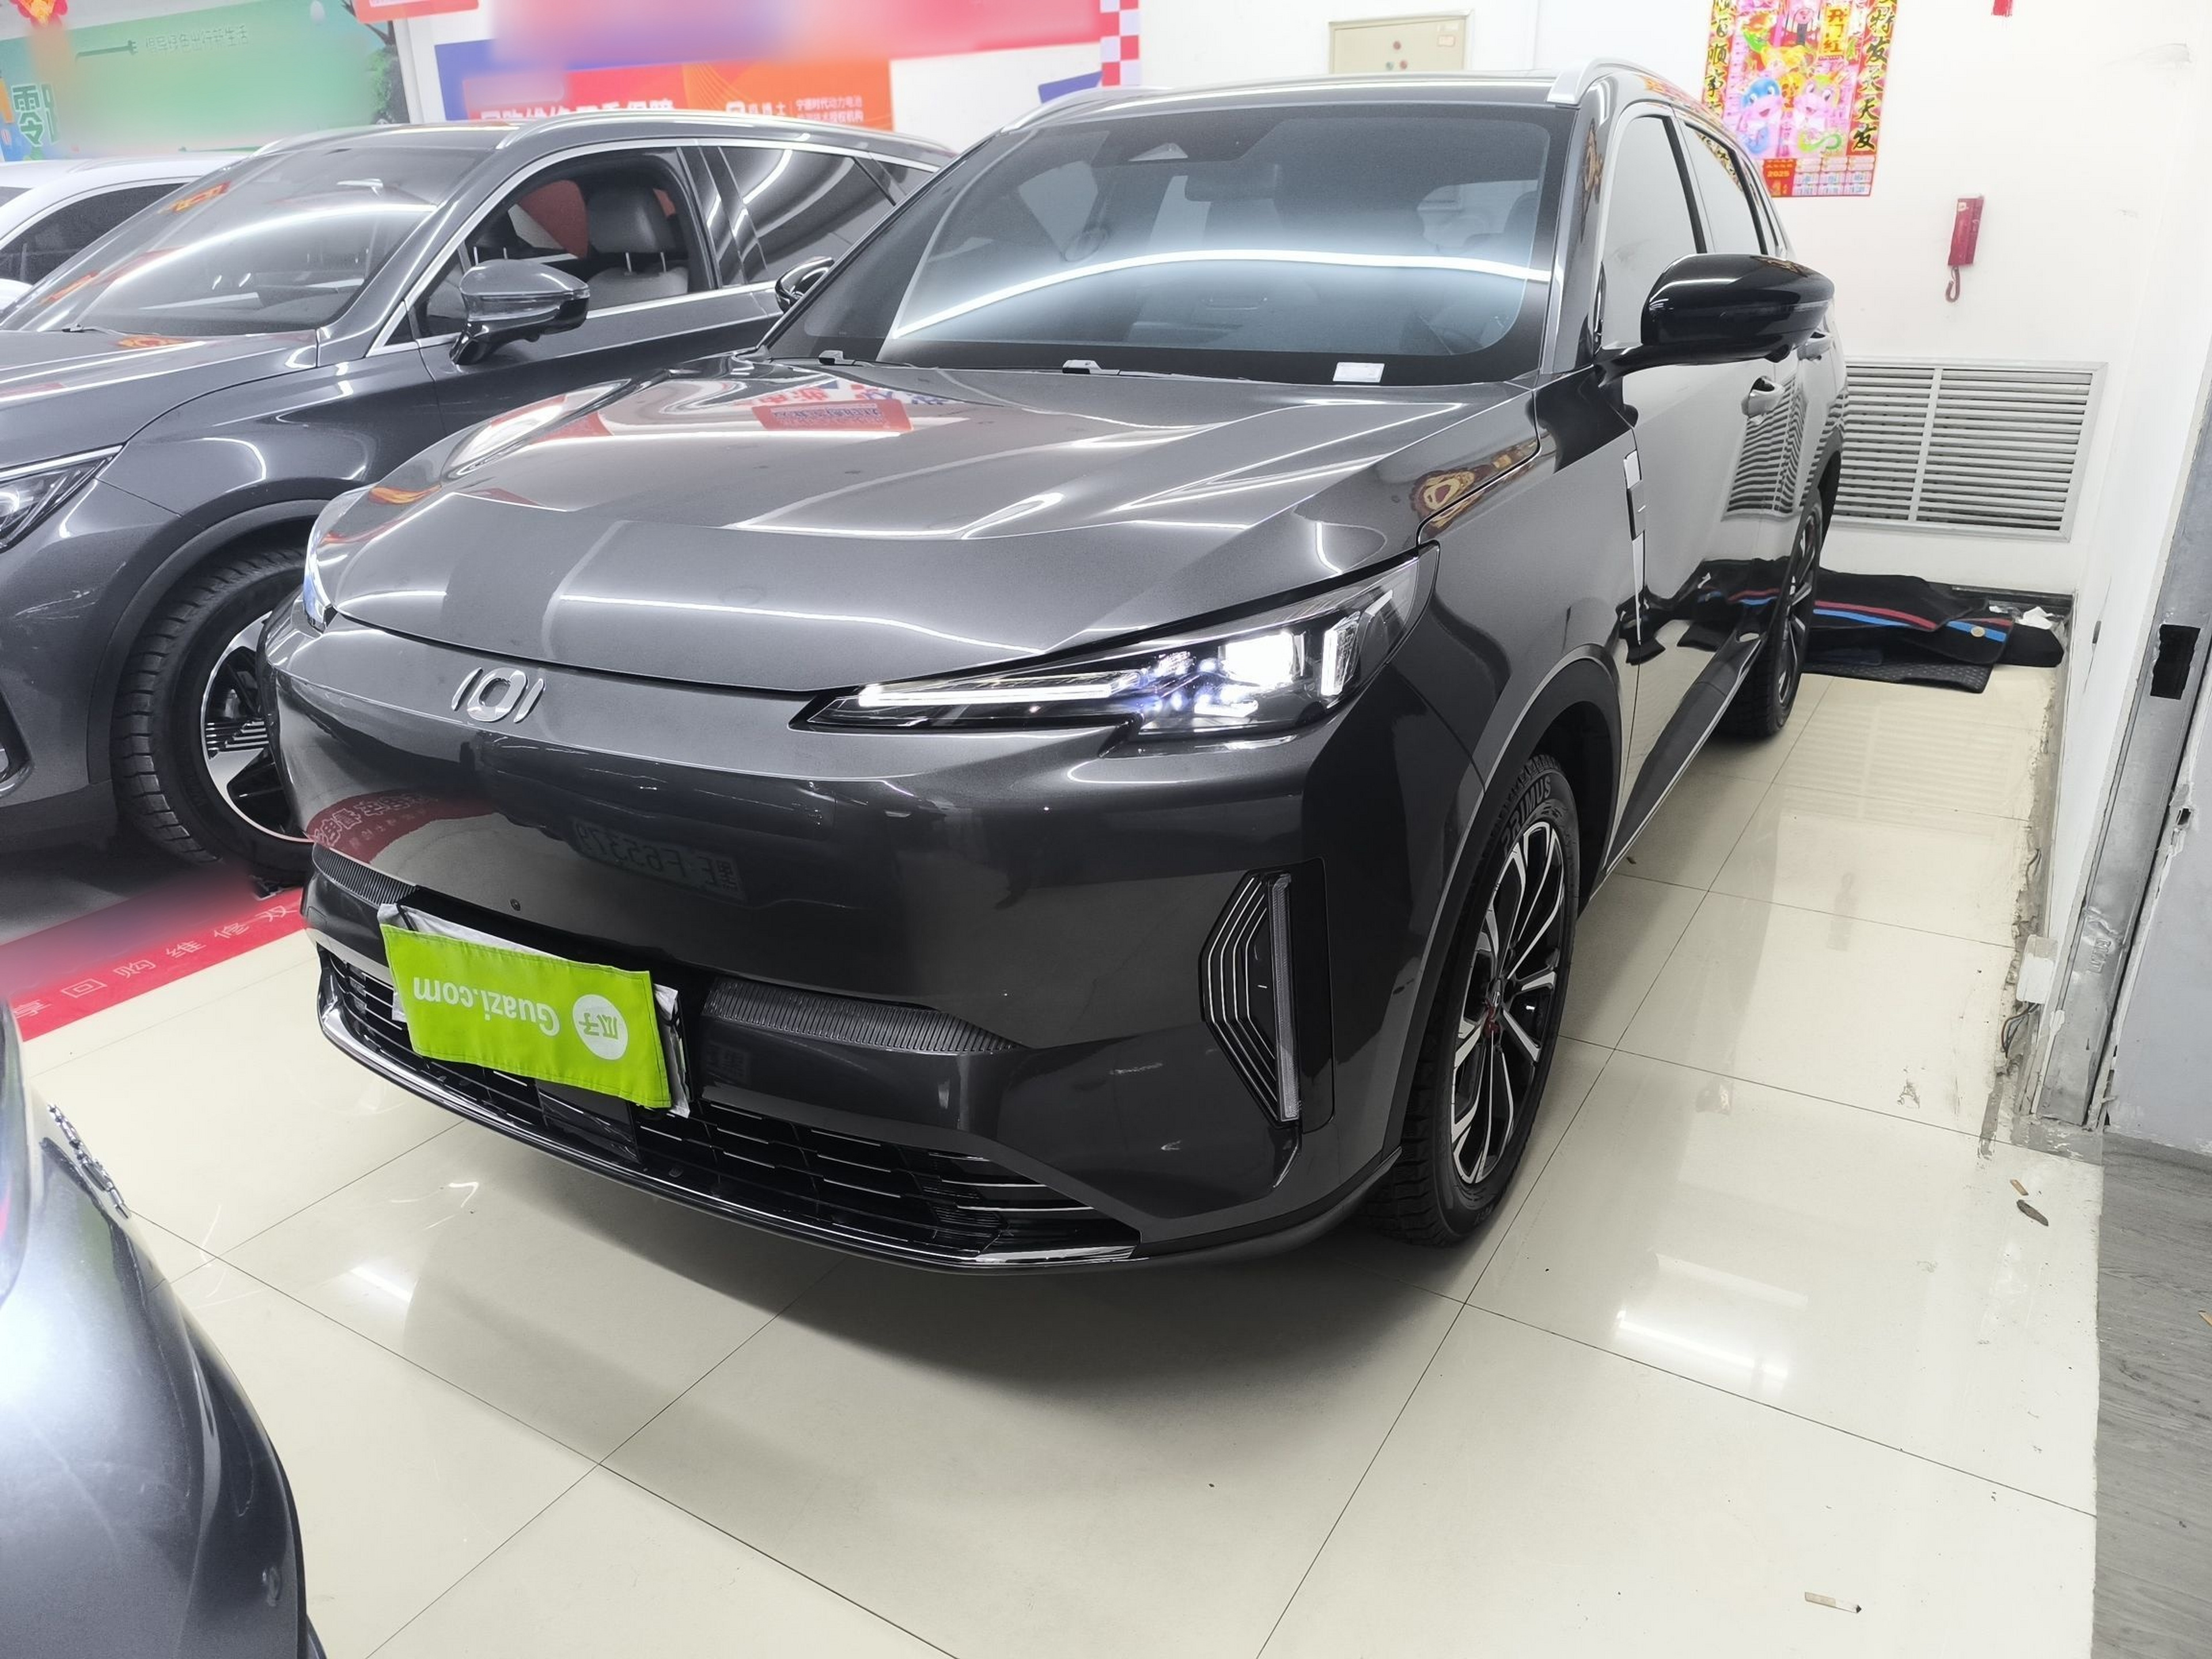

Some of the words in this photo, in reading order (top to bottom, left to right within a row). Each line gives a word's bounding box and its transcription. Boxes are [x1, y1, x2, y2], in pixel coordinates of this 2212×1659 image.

[1767, 170, 1791, 178] 2025
[1501, 775, 1552, 858] PRIMUS
[413, 976, 560, 1037] Guazi.com
